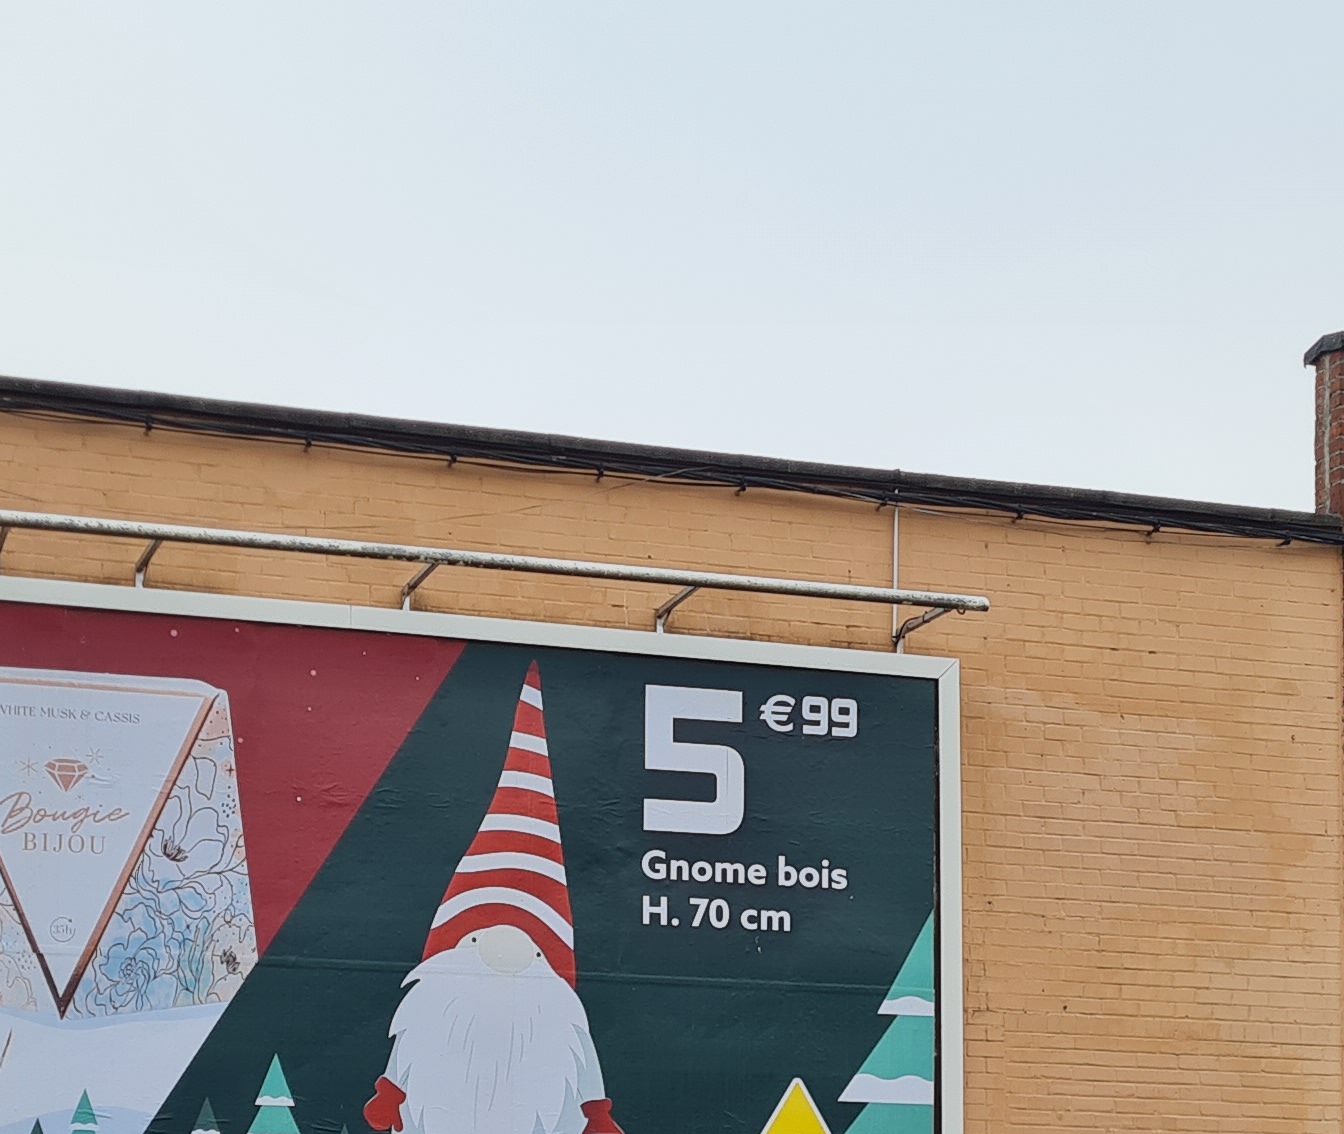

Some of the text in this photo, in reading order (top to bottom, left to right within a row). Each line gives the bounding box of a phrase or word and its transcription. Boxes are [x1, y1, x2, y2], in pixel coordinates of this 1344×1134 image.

[40, 706, 77, 721] MUSK
[79, 709, 91, 720] &
[94, 710, 141, 725] CASSIS
[22, 831, 107, 855] BIJOU
[641, 849, 849, 890] Gnome bois
[642, 894, 792, 932] H. 70 cm
